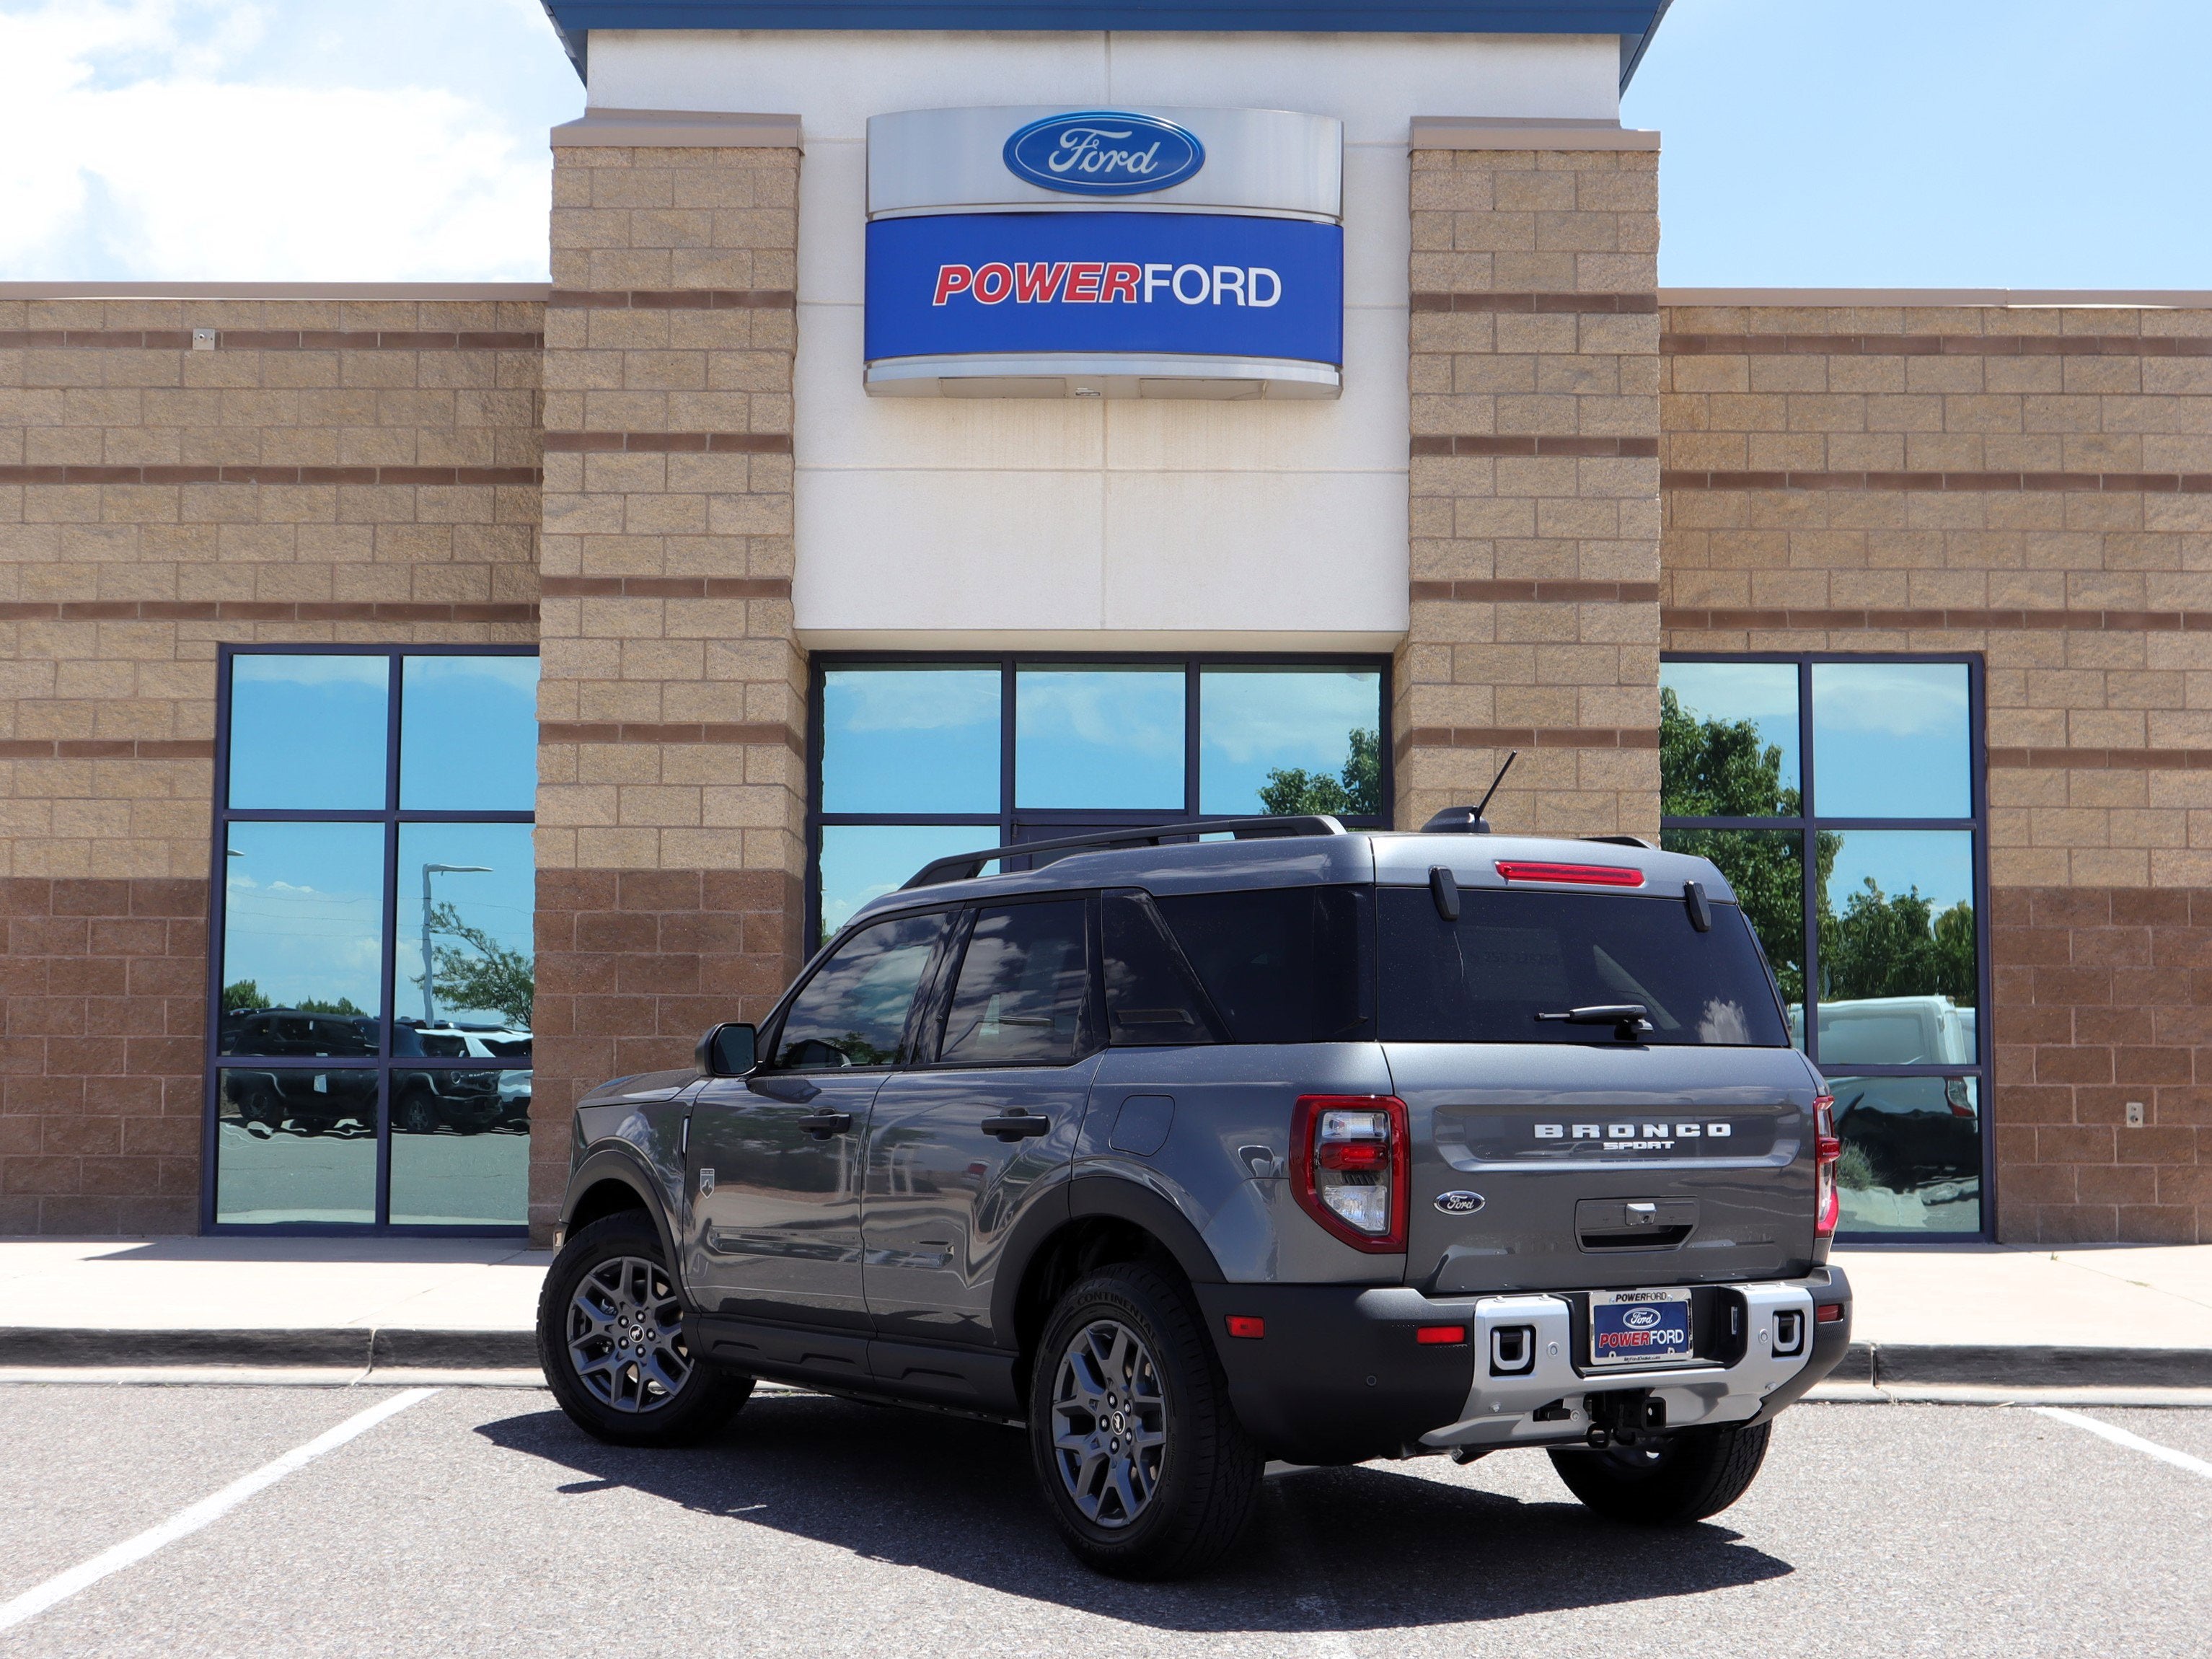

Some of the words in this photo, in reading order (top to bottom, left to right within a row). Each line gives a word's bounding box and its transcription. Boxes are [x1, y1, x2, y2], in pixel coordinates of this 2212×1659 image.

[1048, 126, 1160, 175] Ford
[932, 260, 1282, 308] POWERFORD
[1534, 1123, 1732, 1139] BRONCO
[1603, 1140, 1675, 1151] SPORT
[1447, 1193, 1476, 1210] Ford
[1616, 1292, 1667, 1303] POWERFORD
[1631, 1311, 1654, 1324] Ford
[1598, 1329, 1684, 1348] POWERFORD
